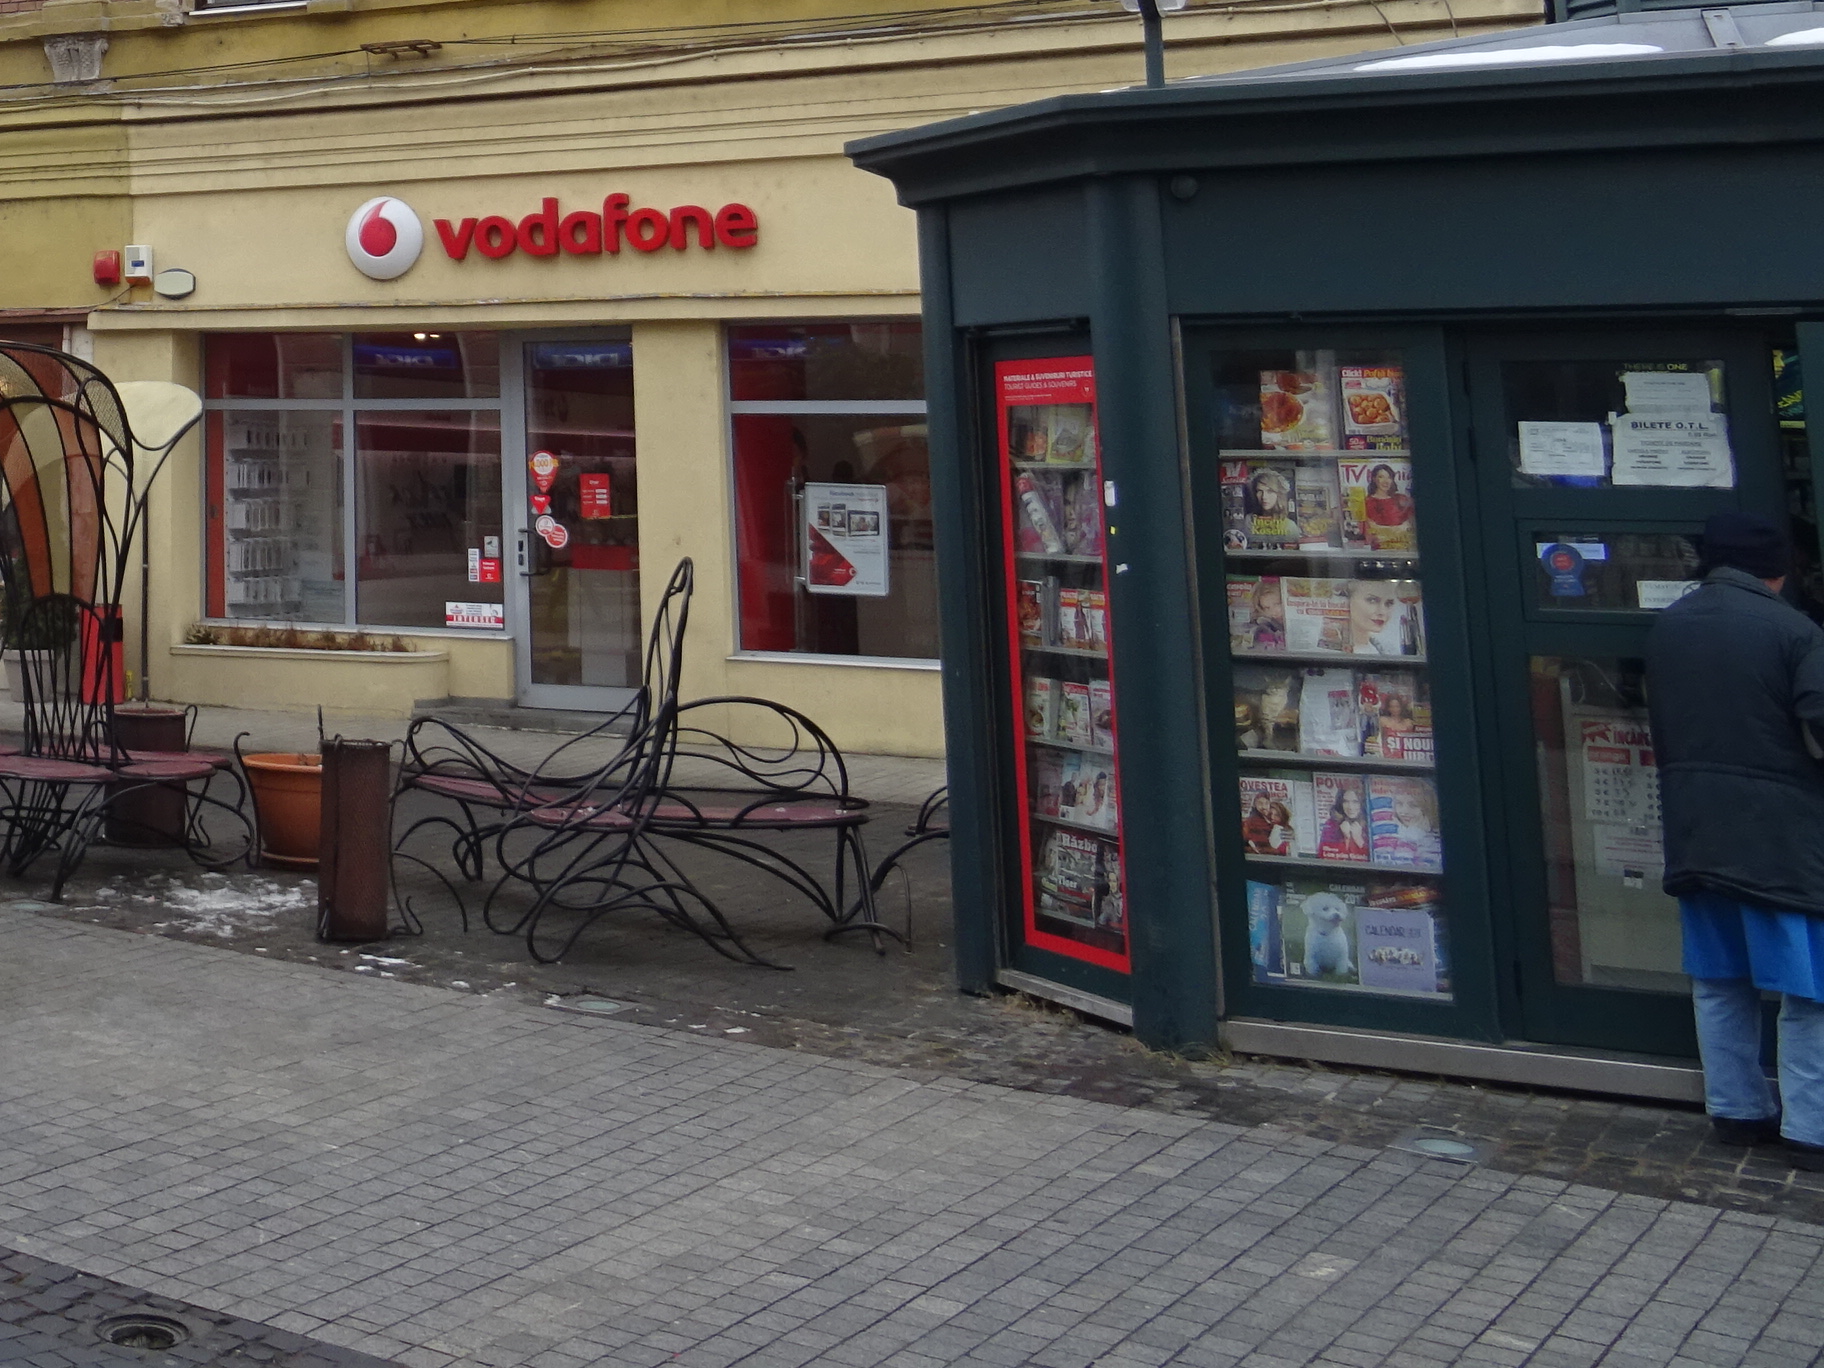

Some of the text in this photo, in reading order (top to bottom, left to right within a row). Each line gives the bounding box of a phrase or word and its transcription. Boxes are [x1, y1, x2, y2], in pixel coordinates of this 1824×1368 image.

[433, 192, 759, 260] vodafone
[1631, 421, 1672, 430] BILETE
[1240, 779, 1288, 792] OVESTEA
